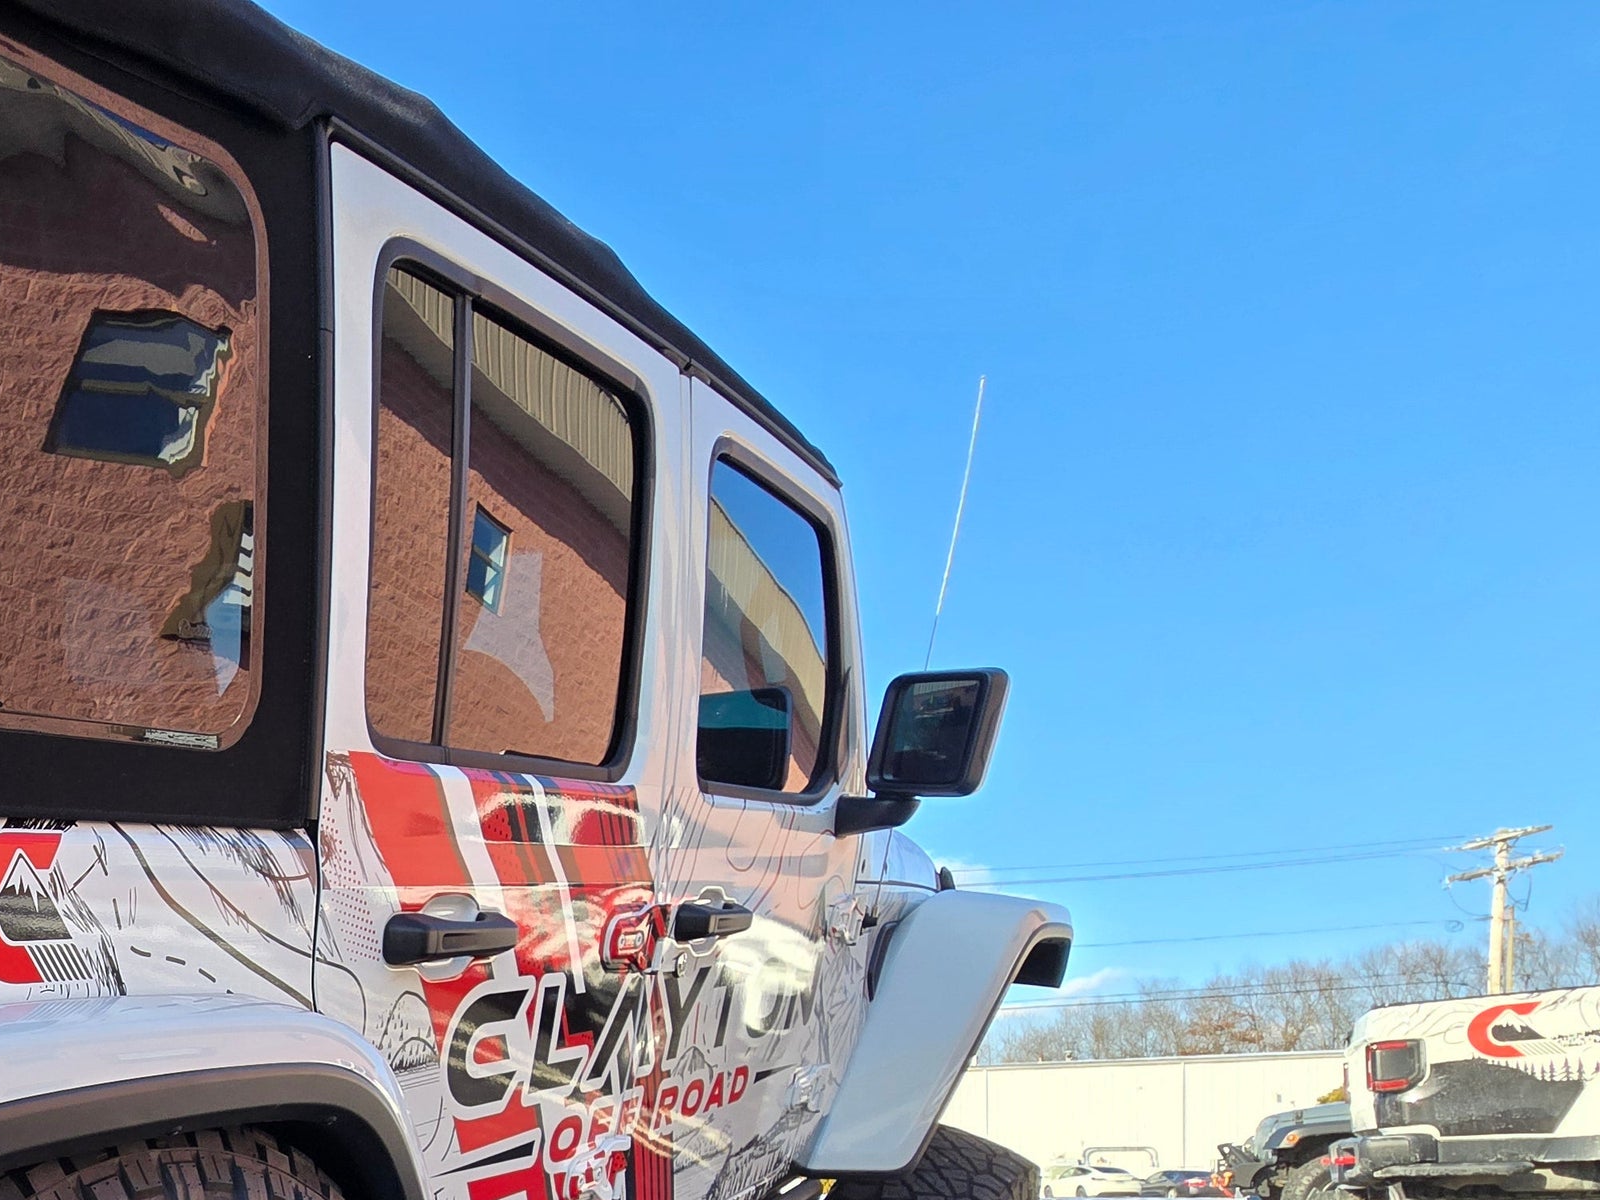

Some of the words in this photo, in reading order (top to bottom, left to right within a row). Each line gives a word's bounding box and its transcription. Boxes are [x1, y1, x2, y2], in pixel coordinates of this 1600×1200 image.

[446, 948, 825, 1108] CLAYTON
[549, 1097, 644, 1163] OFF
[653, 1064, 750, 1131] ROAD
